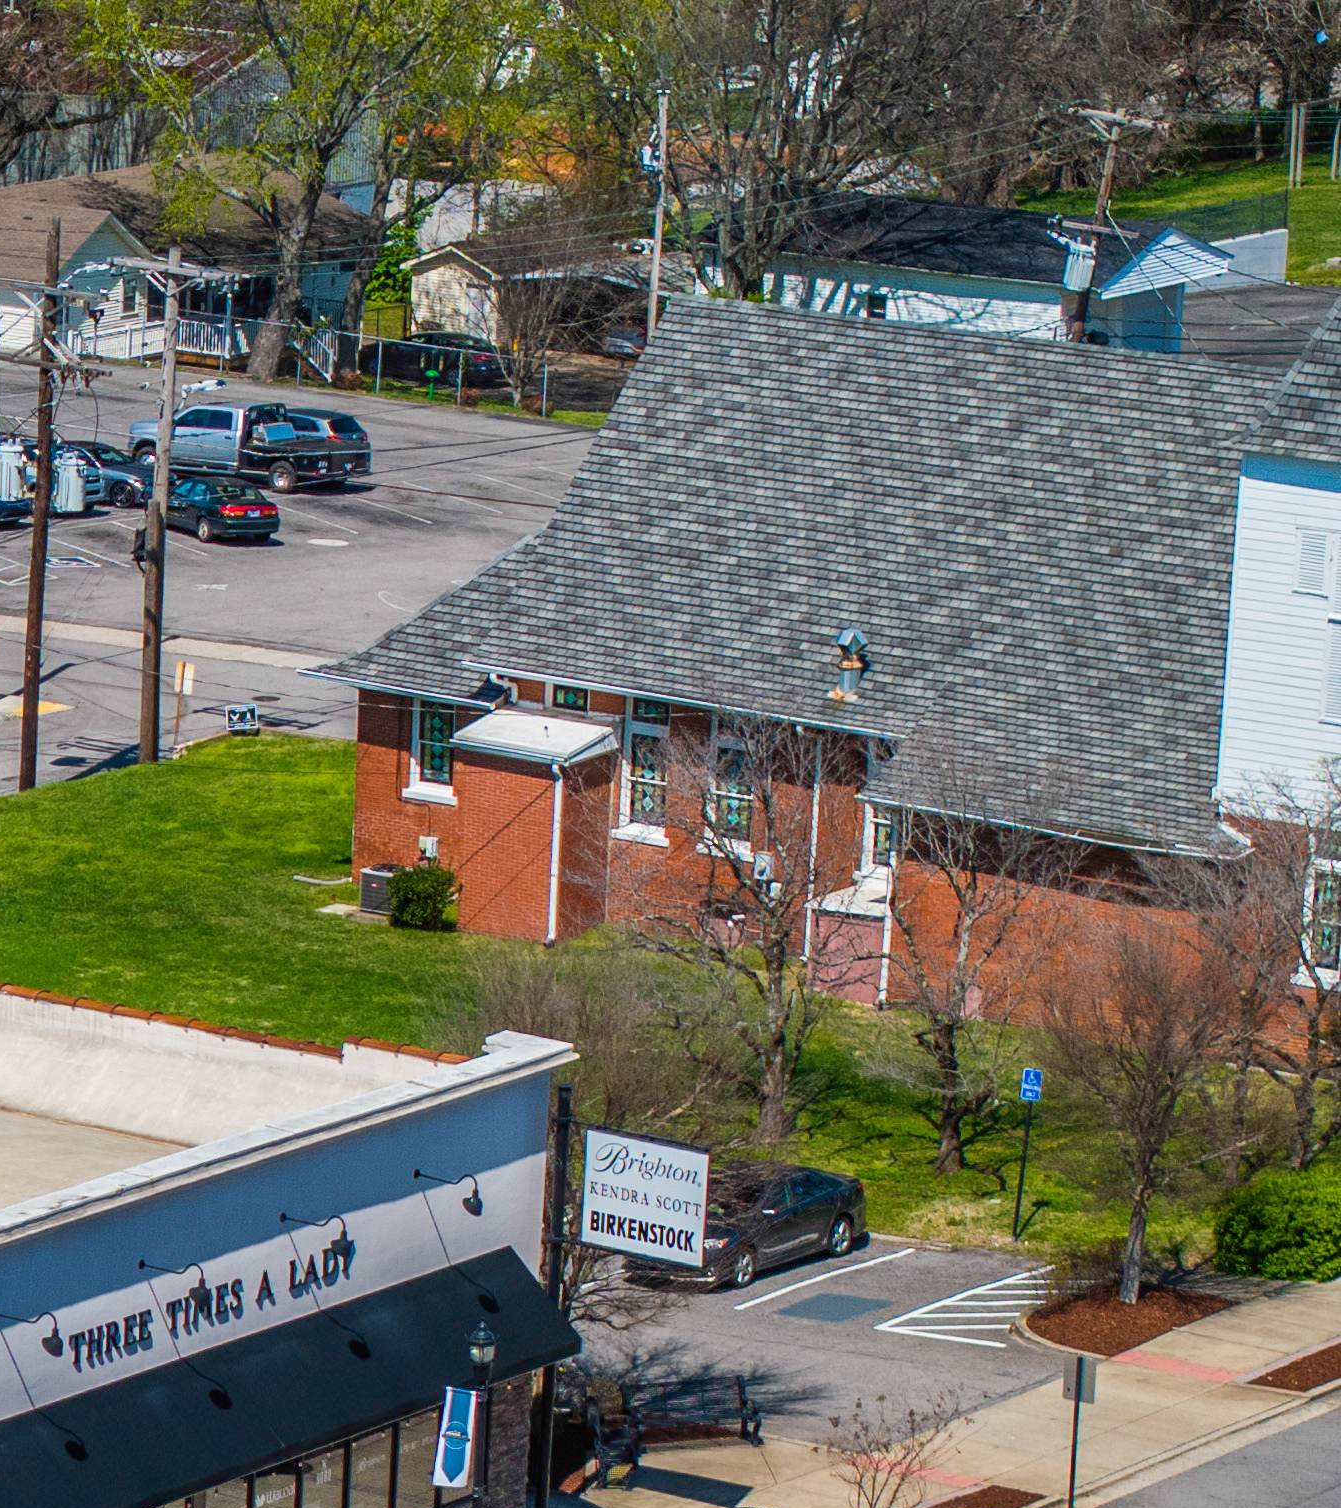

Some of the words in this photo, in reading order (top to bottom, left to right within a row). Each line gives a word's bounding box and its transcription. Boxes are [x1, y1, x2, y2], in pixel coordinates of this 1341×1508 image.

[593, 1142, 697, 1184] Brighton
[590, 1181, 649, 1206] KENDRA
[656, 1195, 702, 1217] SCOTT
[590, 1210, 695, 1252] BIRKENSTOCK
[69, 1309, 152, 1367] THREE
[165, 1278, 244, 1333] TIMES
[256, 1269, 274, 1305] A
